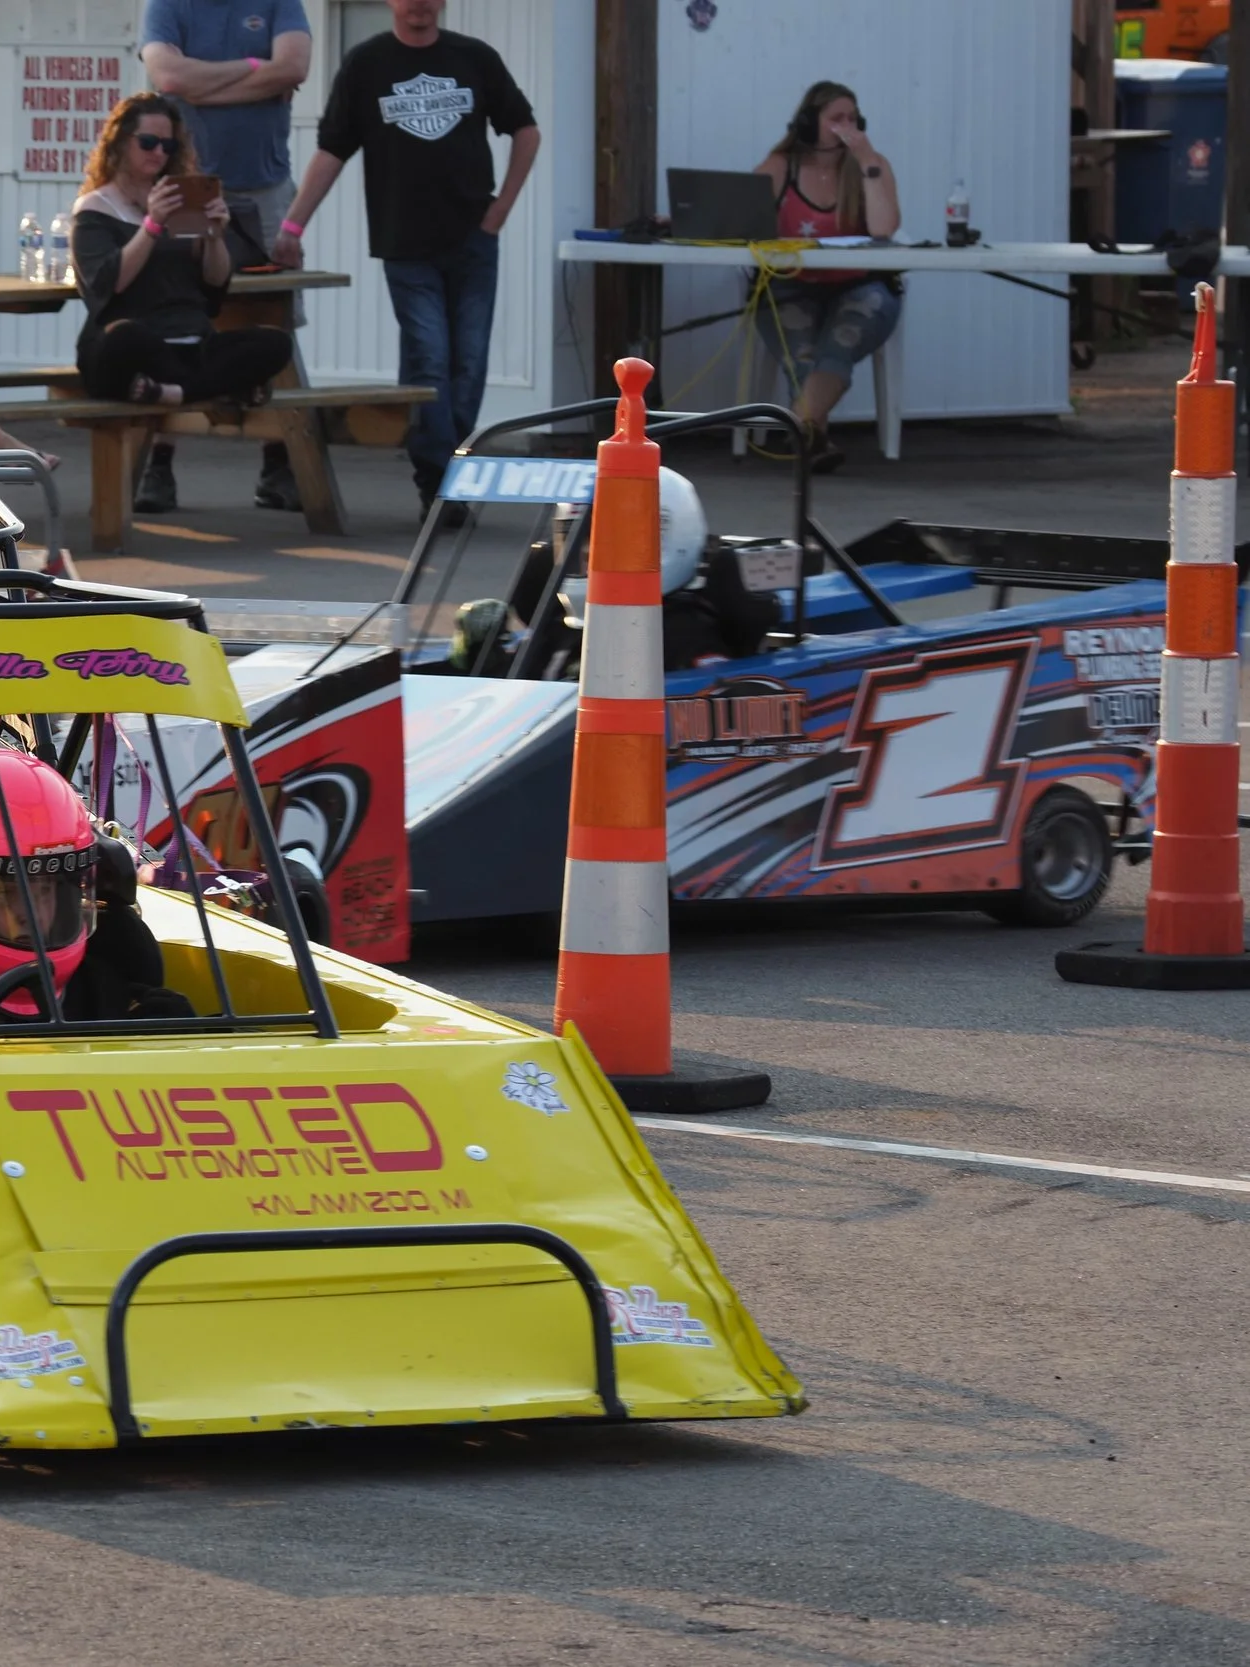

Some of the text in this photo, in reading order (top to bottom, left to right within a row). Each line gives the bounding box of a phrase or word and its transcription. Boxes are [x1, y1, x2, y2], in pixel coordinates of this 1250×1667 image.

[23, 56, 120, 81] ALL VEHICLES AND
[22, 87, 70, 110] PATRONS
[74, 88, 103, 111] MUST
[32, 118, 51, 141] OUT
[56, 118, 68, 141] OF
[72, 118, 90, 141] ALL
[24, 148, 58, 172] AREAS
[62, 149, 77, 172] BY
[447, 461, 596, 498] AJ WHITE
[54, 648, 190, 685] Terry
[820, 645, 1032, 864] 1
[7, 1083, 443, 1181] TWISTED
[116, 1146, 369, 1181] AUTOMOTIVE
[250, 1188, 473, 1216] KALAMAZOO, MI
